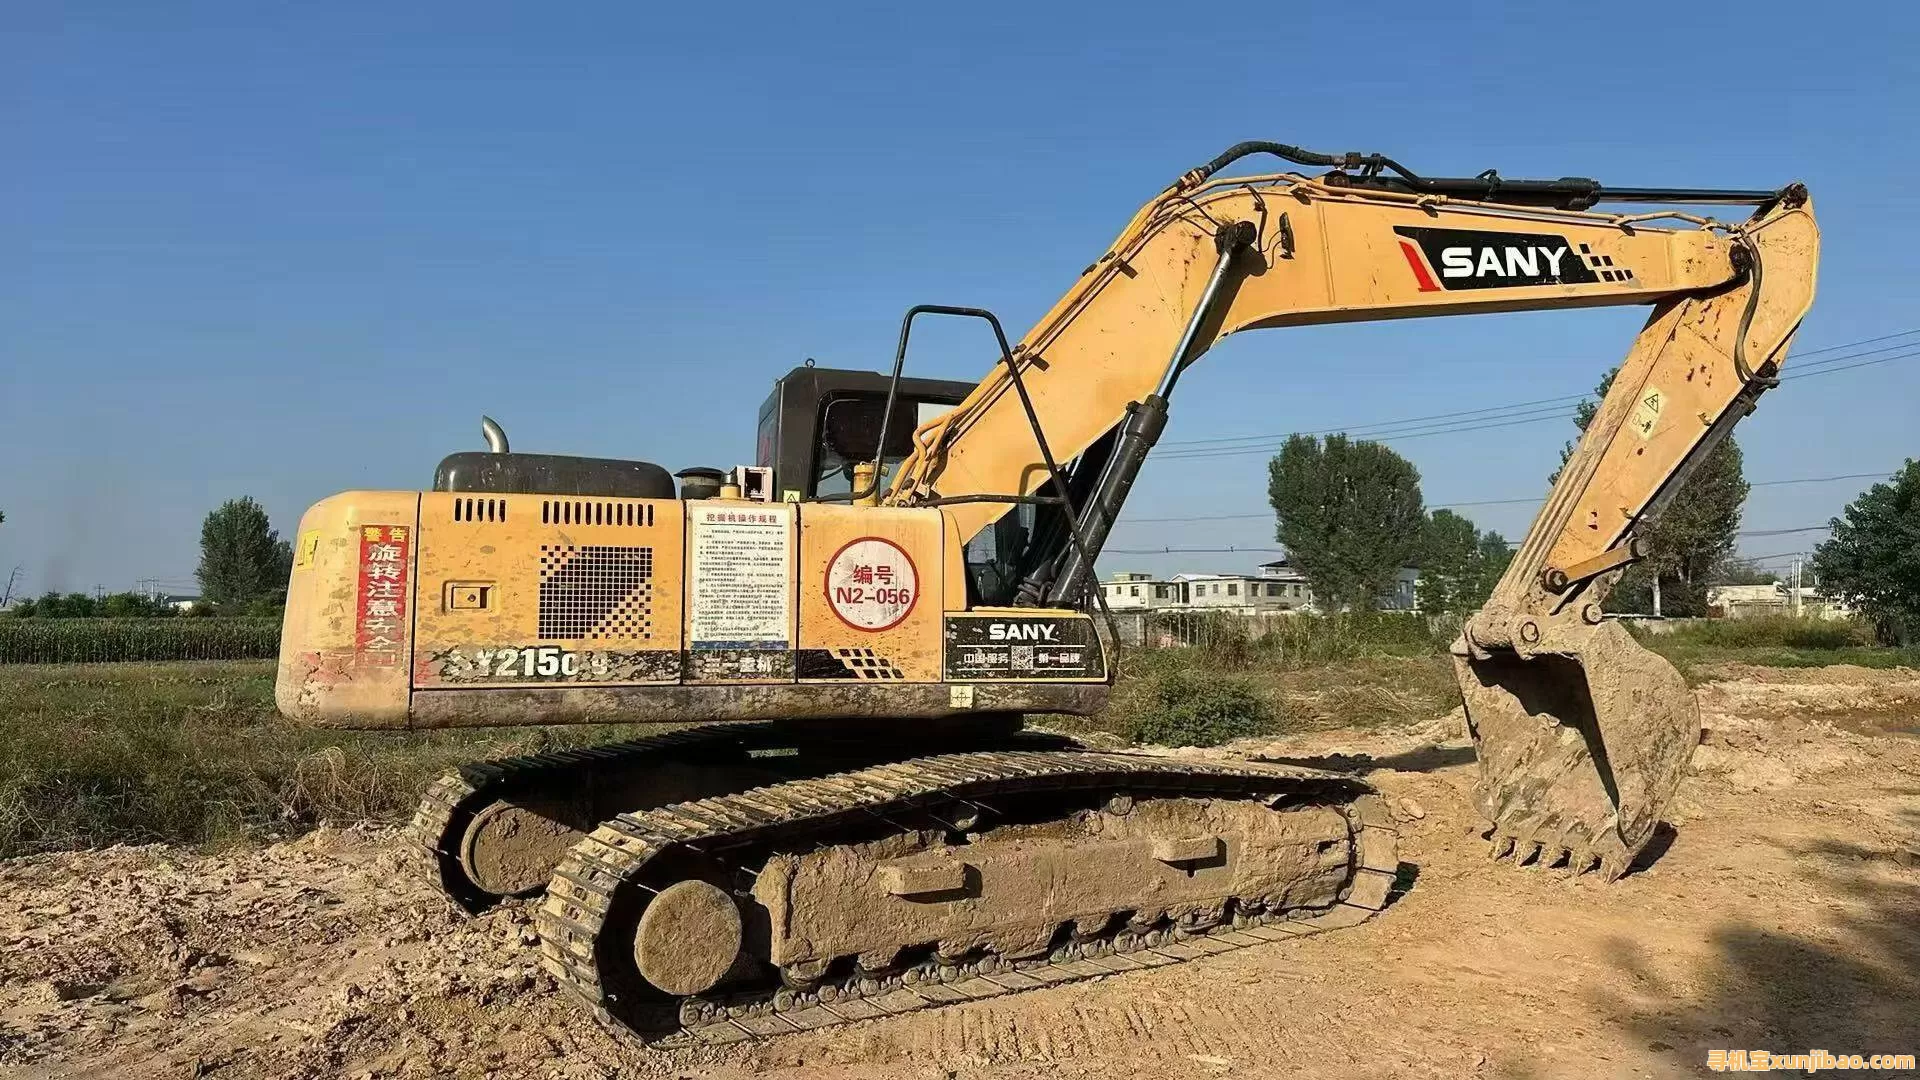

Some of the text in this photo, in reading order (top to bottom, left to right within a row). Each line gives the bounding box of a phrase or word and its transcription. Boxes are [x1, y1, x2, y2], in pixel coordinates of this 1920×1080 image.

[1441, 246, 1567, 278] SANY
[706, 513, 777, 523] 挖掘机操作规程
[364, 527, 407, 542] 警告
[853, 564, 893, 585] 编号
[836, 587, 910, 605] N2-056
[989, 623, 1056, 640] SANY
